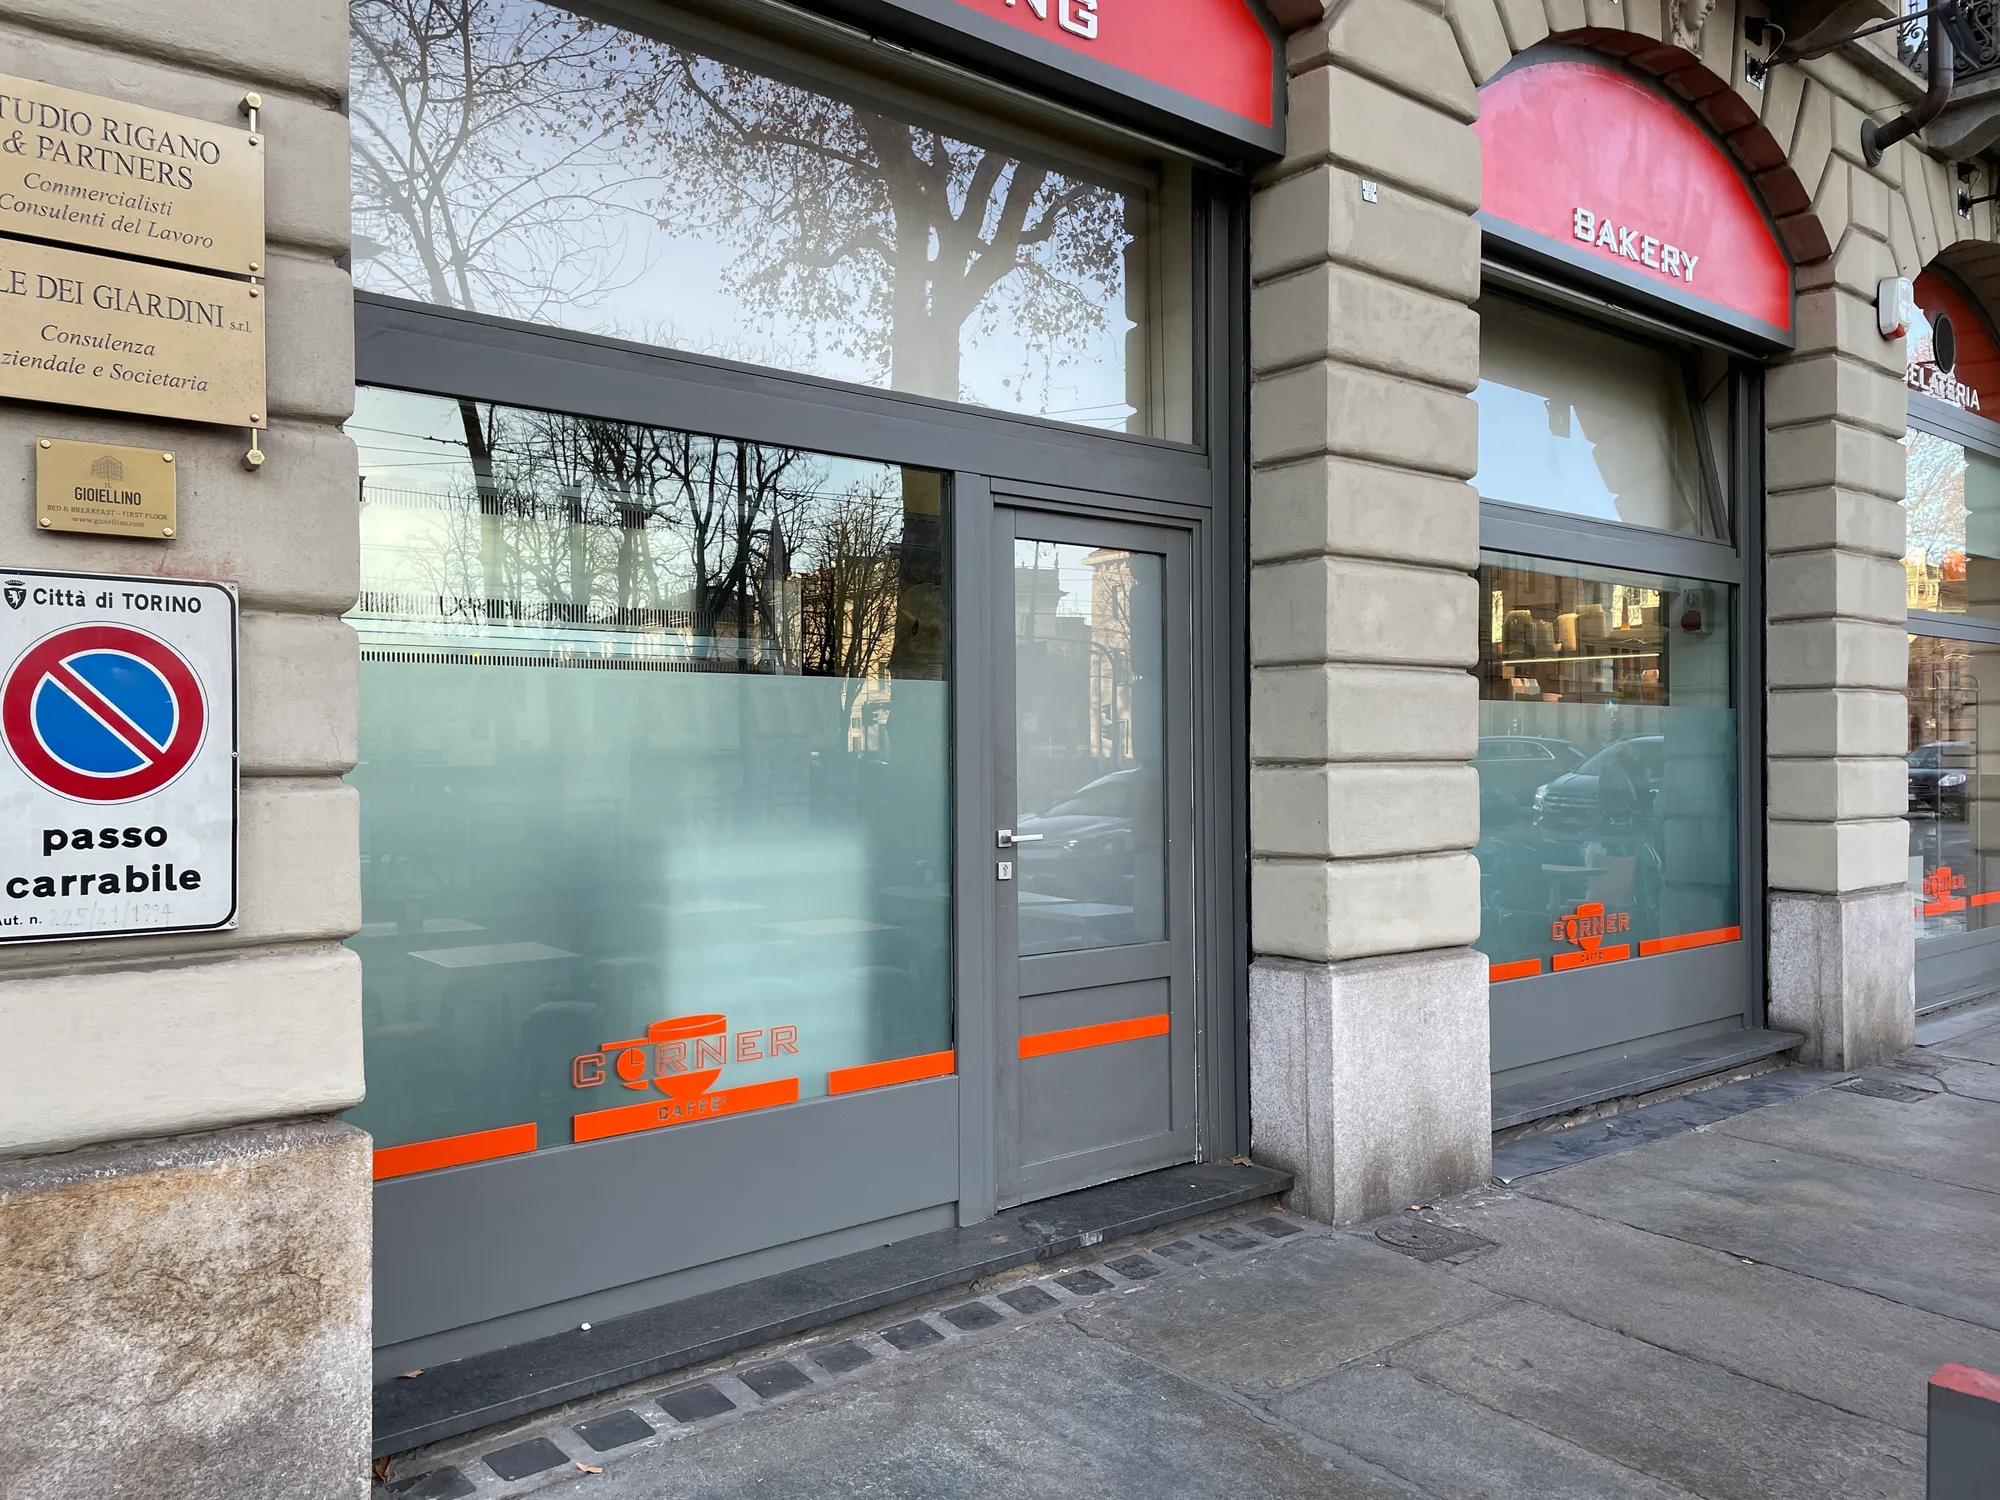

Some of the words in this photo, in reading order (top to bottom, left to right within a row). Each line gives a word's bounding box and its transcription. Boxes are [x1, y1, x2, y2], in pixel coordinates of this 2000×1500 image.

[101, 117, 220, 165] RIGANO
[3, 130, 26, 155] &
[36, 135, 194, 190] PARTNERS
[24, 172, 173, 216] Commercialisti
[0, 193, 105, 228] Consulenti
[111, 215, 141, 234] del
[148, 221, 214, 248] Lavoro
[1573, 207, 1700, 282] BAKERY
[36, 274, 84, 305] DEI
[93, 284, 224, 328] GIARDINI
[230, 320, 252, 333] s.r.l.
[41, 324, 156, 356] Consulenza
[92, 366, 104, 377] e
[110, 363, 208, 392] Societaria
[1903, 362, 1980, 411] ELATERIA
[74, 487, 141, 506] GIOIELLINO
[71, 507, 115, 516] BREAKFAST
[122, 511, 143, 519] FIRST
[145, 512, 168, 521] FLOOR
[72, 517, 144, 528] www.gioiellino.com
[33, 588, 86, 607] Città
[95, 591, 113, 609] di
[122, 593, 202, 614] TORINO
[43, 825, 168, 856] passo
[6, 863, 201, 899] carrabile
[29, 916, 42, 924] n.
[1552, 912, 1630, 941] CORNER
[572, 1025, 799, 1088] CORNER
